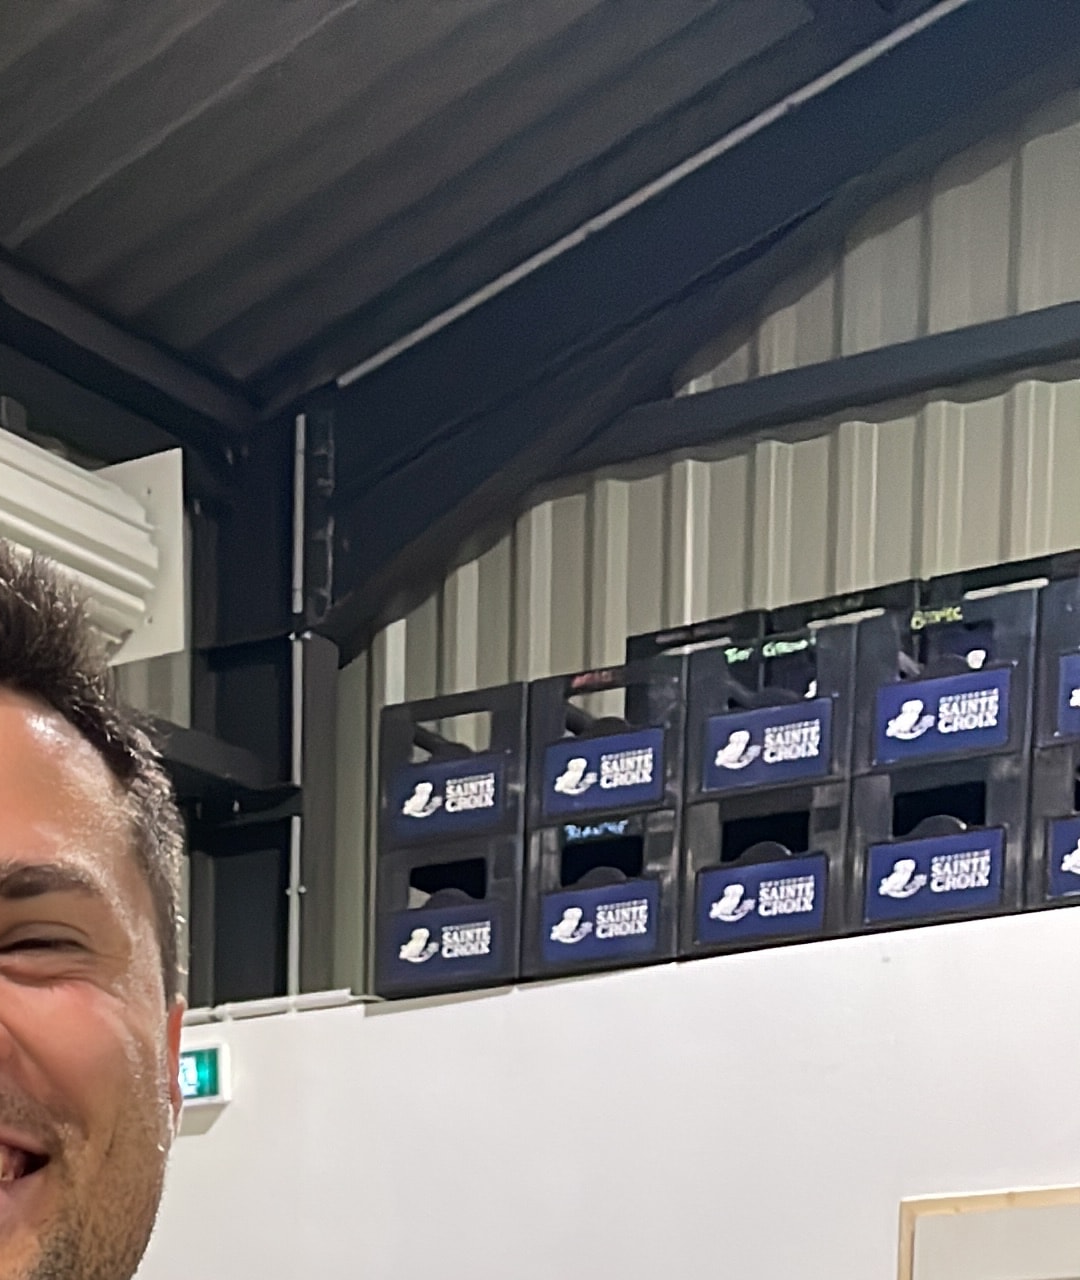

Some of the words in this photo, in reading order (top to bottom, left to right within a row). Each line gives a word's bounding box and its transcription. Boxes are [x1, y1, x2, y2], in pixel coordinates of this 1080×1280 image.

[939, 695, 998, 718] SAINTE
[938, 710, 997, 733] CROIX
[764, 726, 819, 748] SAINTE
[763, 740, 819, 763] CROIX
[601, 754, 652, 776] SAINTE
[600, 769, 652, 788] CROIX
[446, 779, 494, 799] SAINTE
[445, 793, 494, 812] CROIX
[931, 855, 990, 878] SAINTE
[930, 871, 989, 892] CROIX
[759, 882, 814, 902] SAINTE
[596, 905, 647, 925] SAINTE
[758, 896, 813, 916] CROIX
[442, 926, 490, 945] SAINTE
[596, 919, 647, 938] CROIX
[442, 940, 490, 958] CROIX
